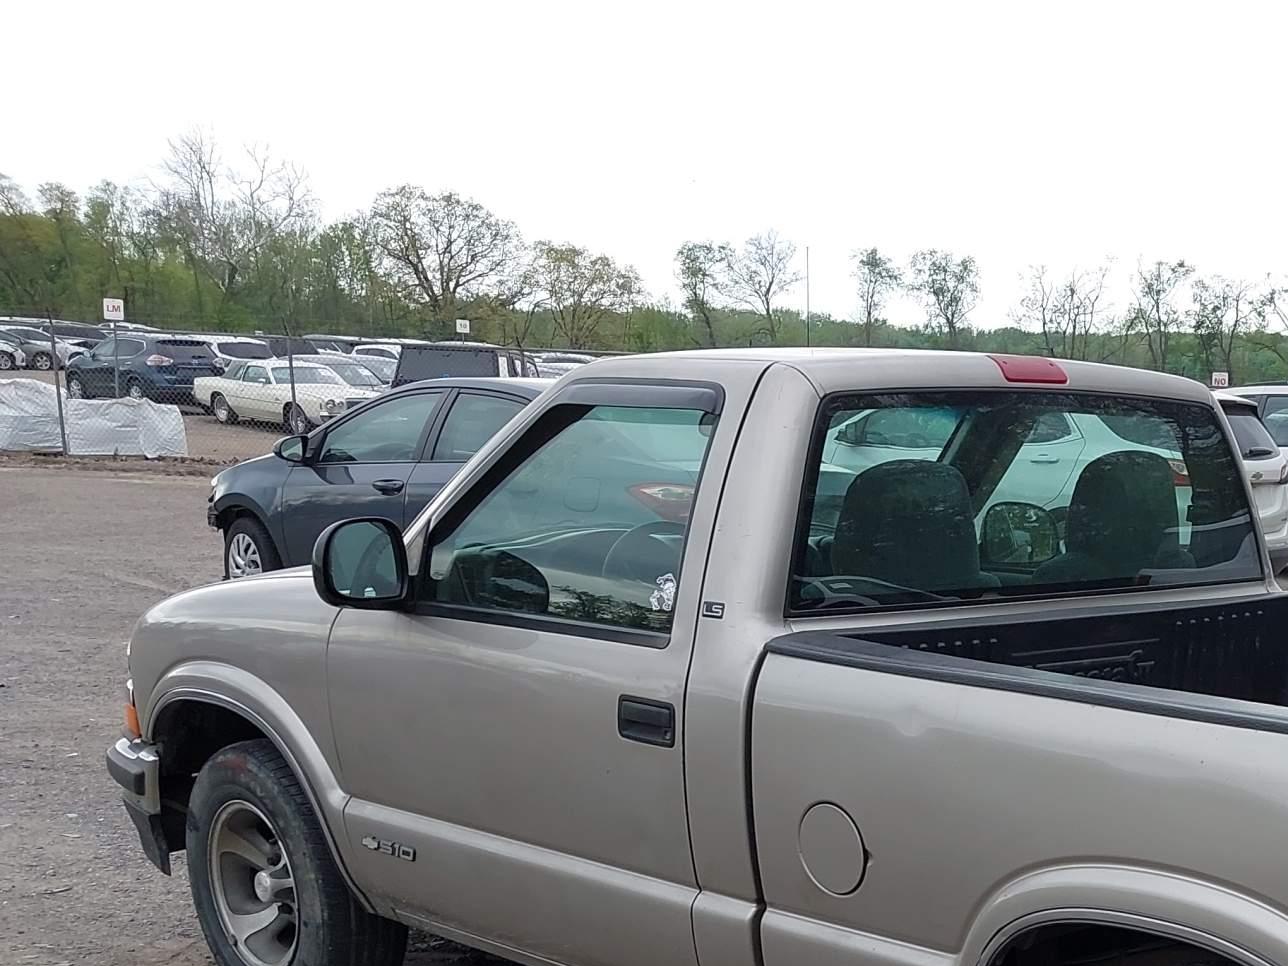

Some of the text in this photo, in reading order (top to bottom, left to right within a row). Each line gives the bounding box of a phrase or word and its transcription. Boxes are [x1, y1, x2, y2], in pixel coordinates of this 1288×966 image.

[106, 304, 121, 313] LM
[1214, 377, 1227, 386] NO
[703, 603, 723, 616] LS
[379, 840, 414, 861] S10
